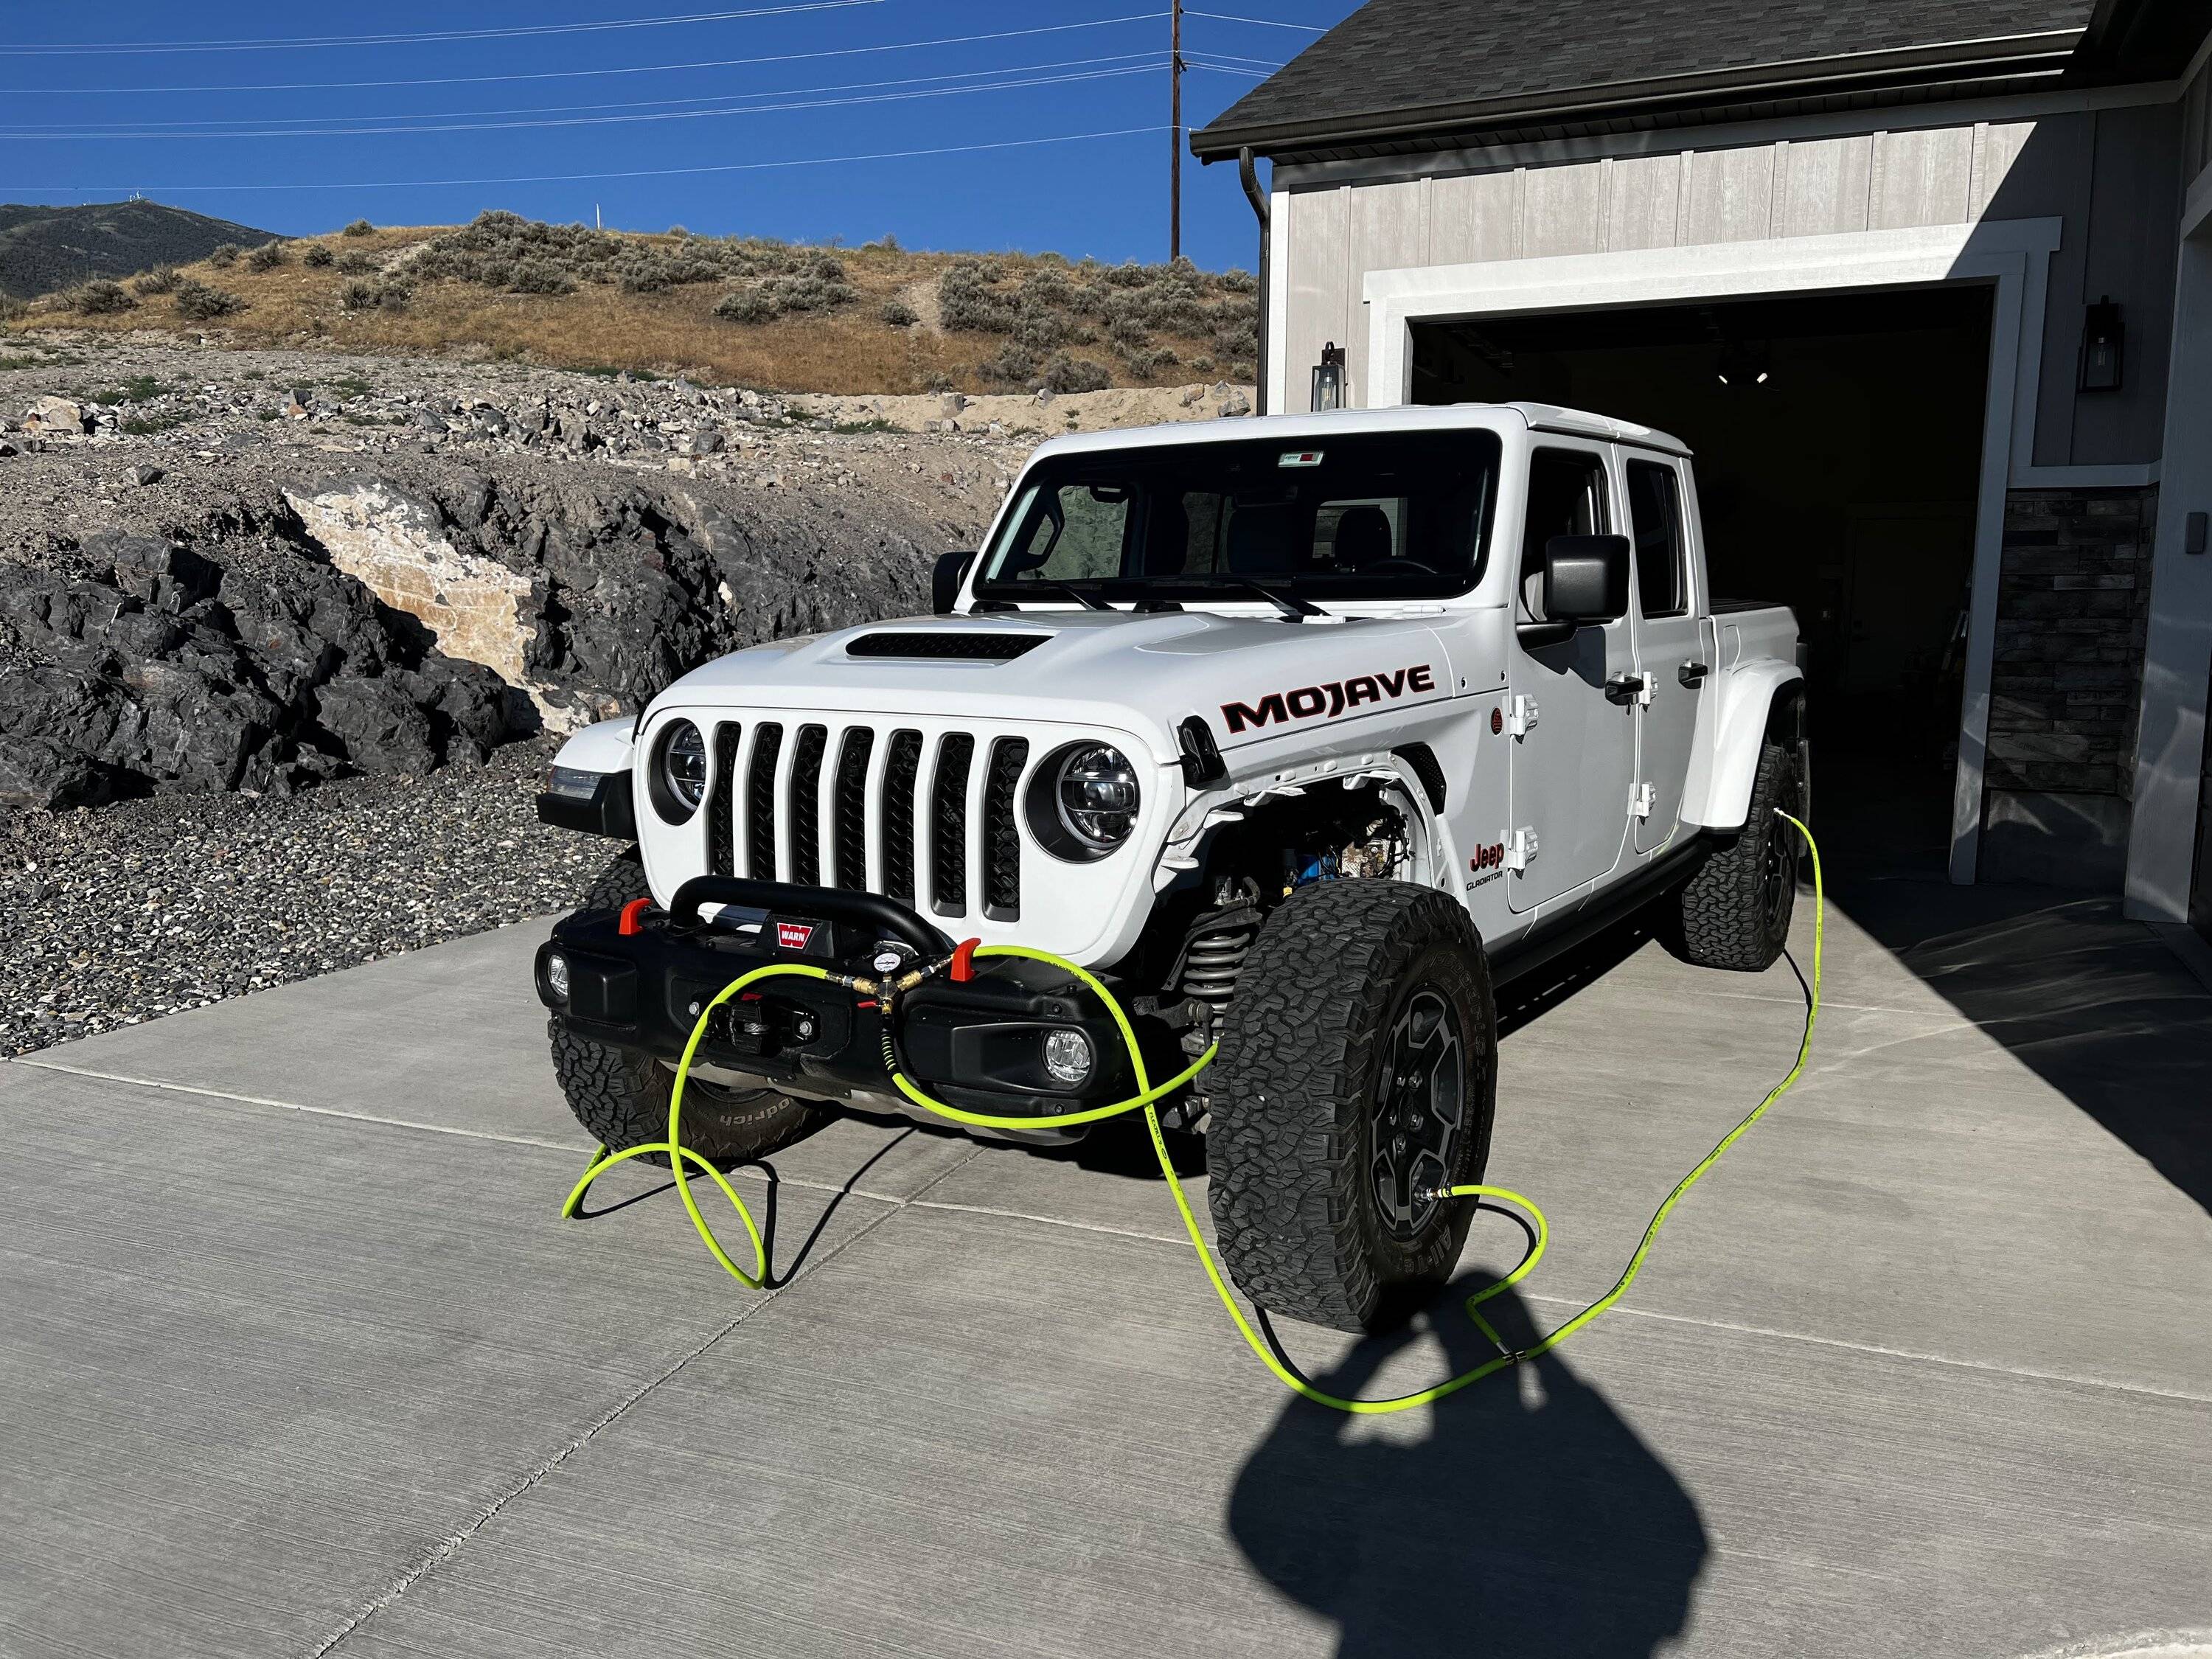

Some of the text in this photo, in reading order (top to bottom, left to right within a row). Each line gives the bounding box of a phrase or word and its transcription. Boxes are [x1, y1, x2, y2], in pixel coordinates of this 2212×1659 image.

[1220, 664, 1435, 734] MOJAVE
[1470, 843, 1504, 872] Jeep
[1466, 870, 1503, 891] GLADIATOR
[782, 931, 805, 942] WARN
[720, 1097, 790, 1127] odrich
